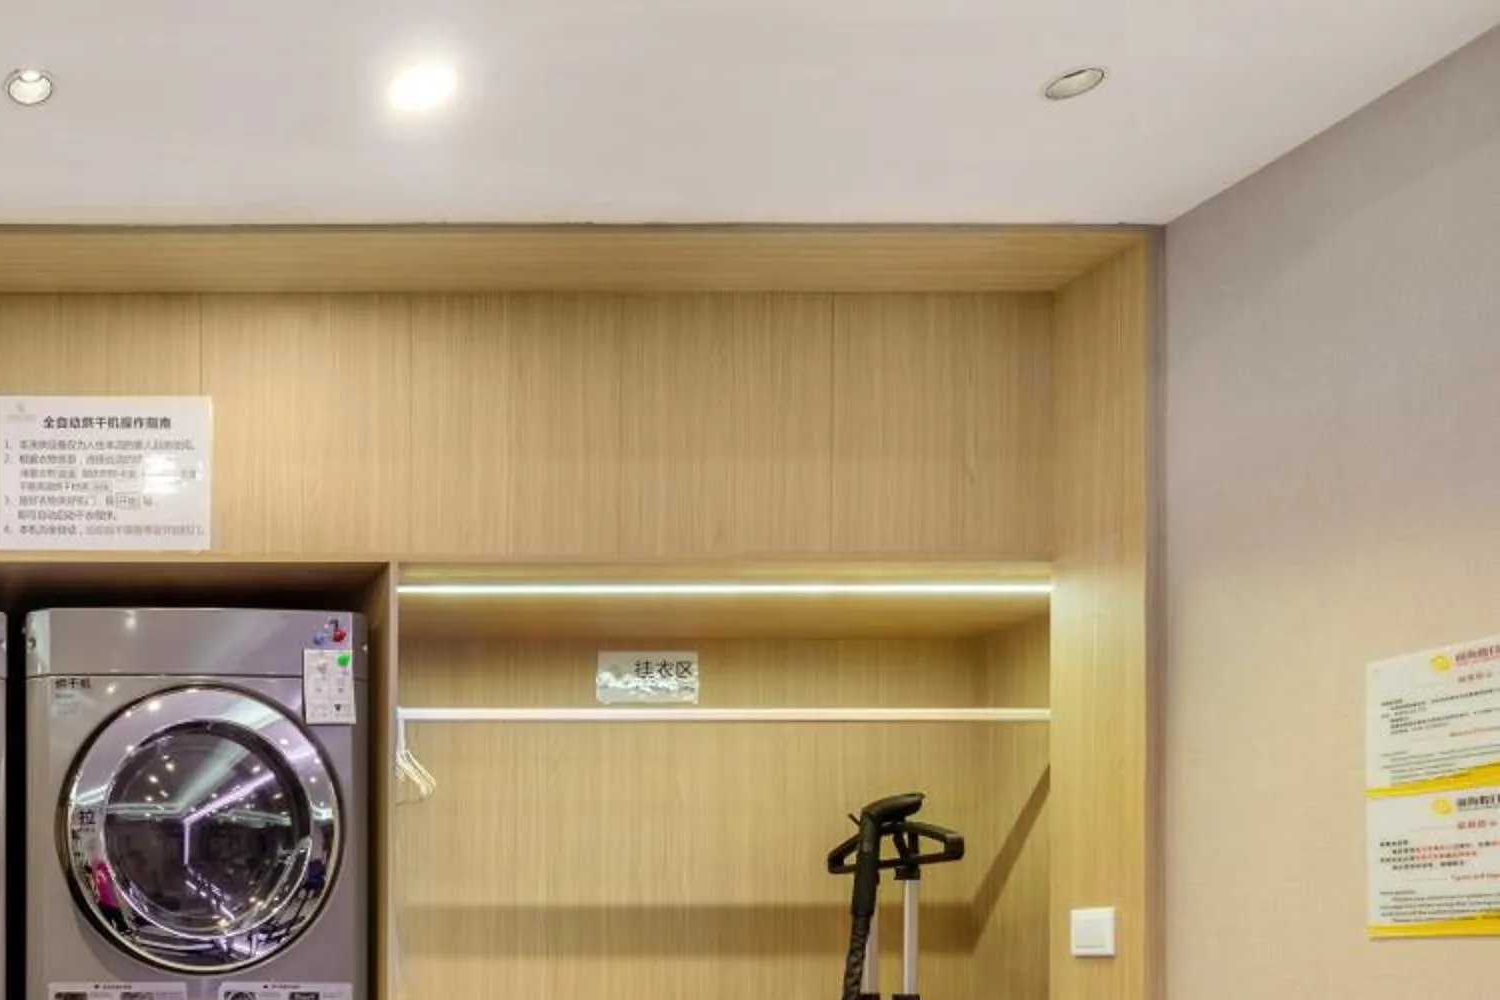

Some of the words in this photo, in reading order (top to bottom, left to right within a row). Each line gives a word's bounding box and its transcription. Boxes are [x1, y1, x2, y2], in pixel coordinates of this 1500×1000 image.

[43, 415, 172, 429] 全自动烘干机操作指南
[633, 659, 693, 679] 挂衣区
